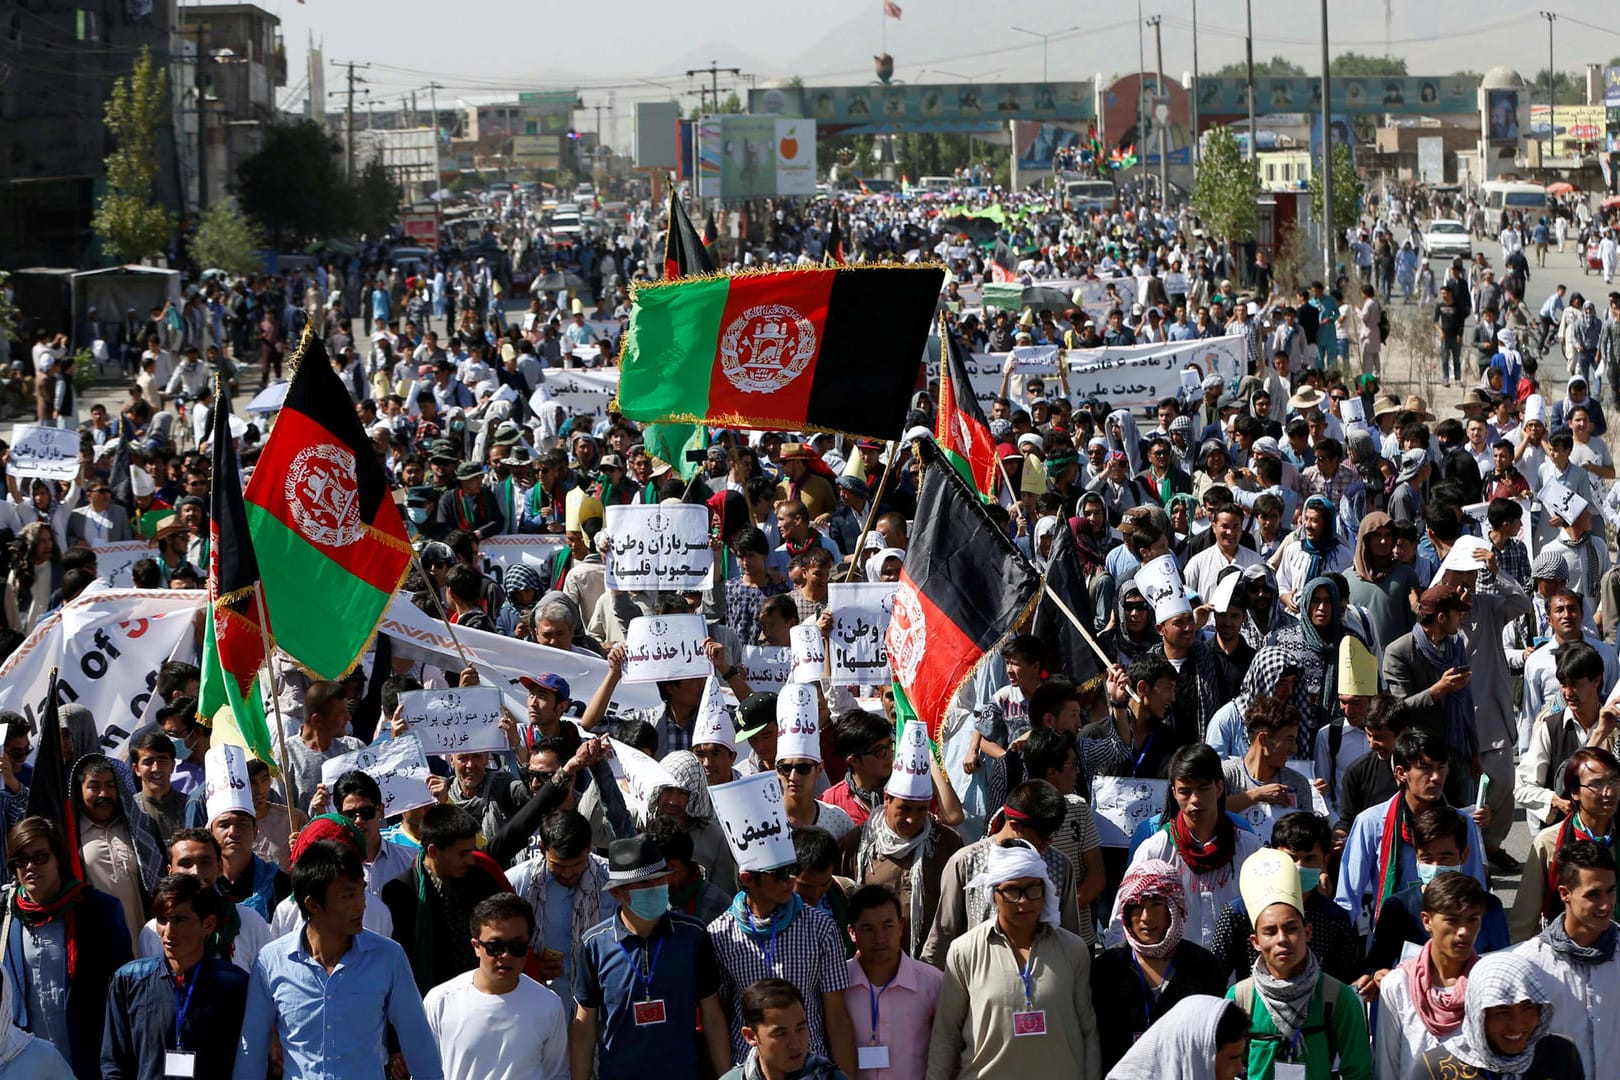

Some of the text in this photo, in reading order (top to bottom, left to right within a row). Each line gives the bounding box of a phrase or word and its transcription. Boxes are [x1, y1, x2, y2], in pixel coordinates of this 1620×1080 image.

[648, 534, 710, 555] سربازان
[610, 559, 709, 582] محبوب قلبها!
[837, 617, 880, 643] وطن؛
[80, 628, 122, 680] of
[651, 641, 679, 661] حذف
[836, 647, 888, 673] قلبها!
[790, 713, 816, 735] حذف
[906, 753, 929, 776] حذف
[726, 811, 782, 851] تبعیض!
